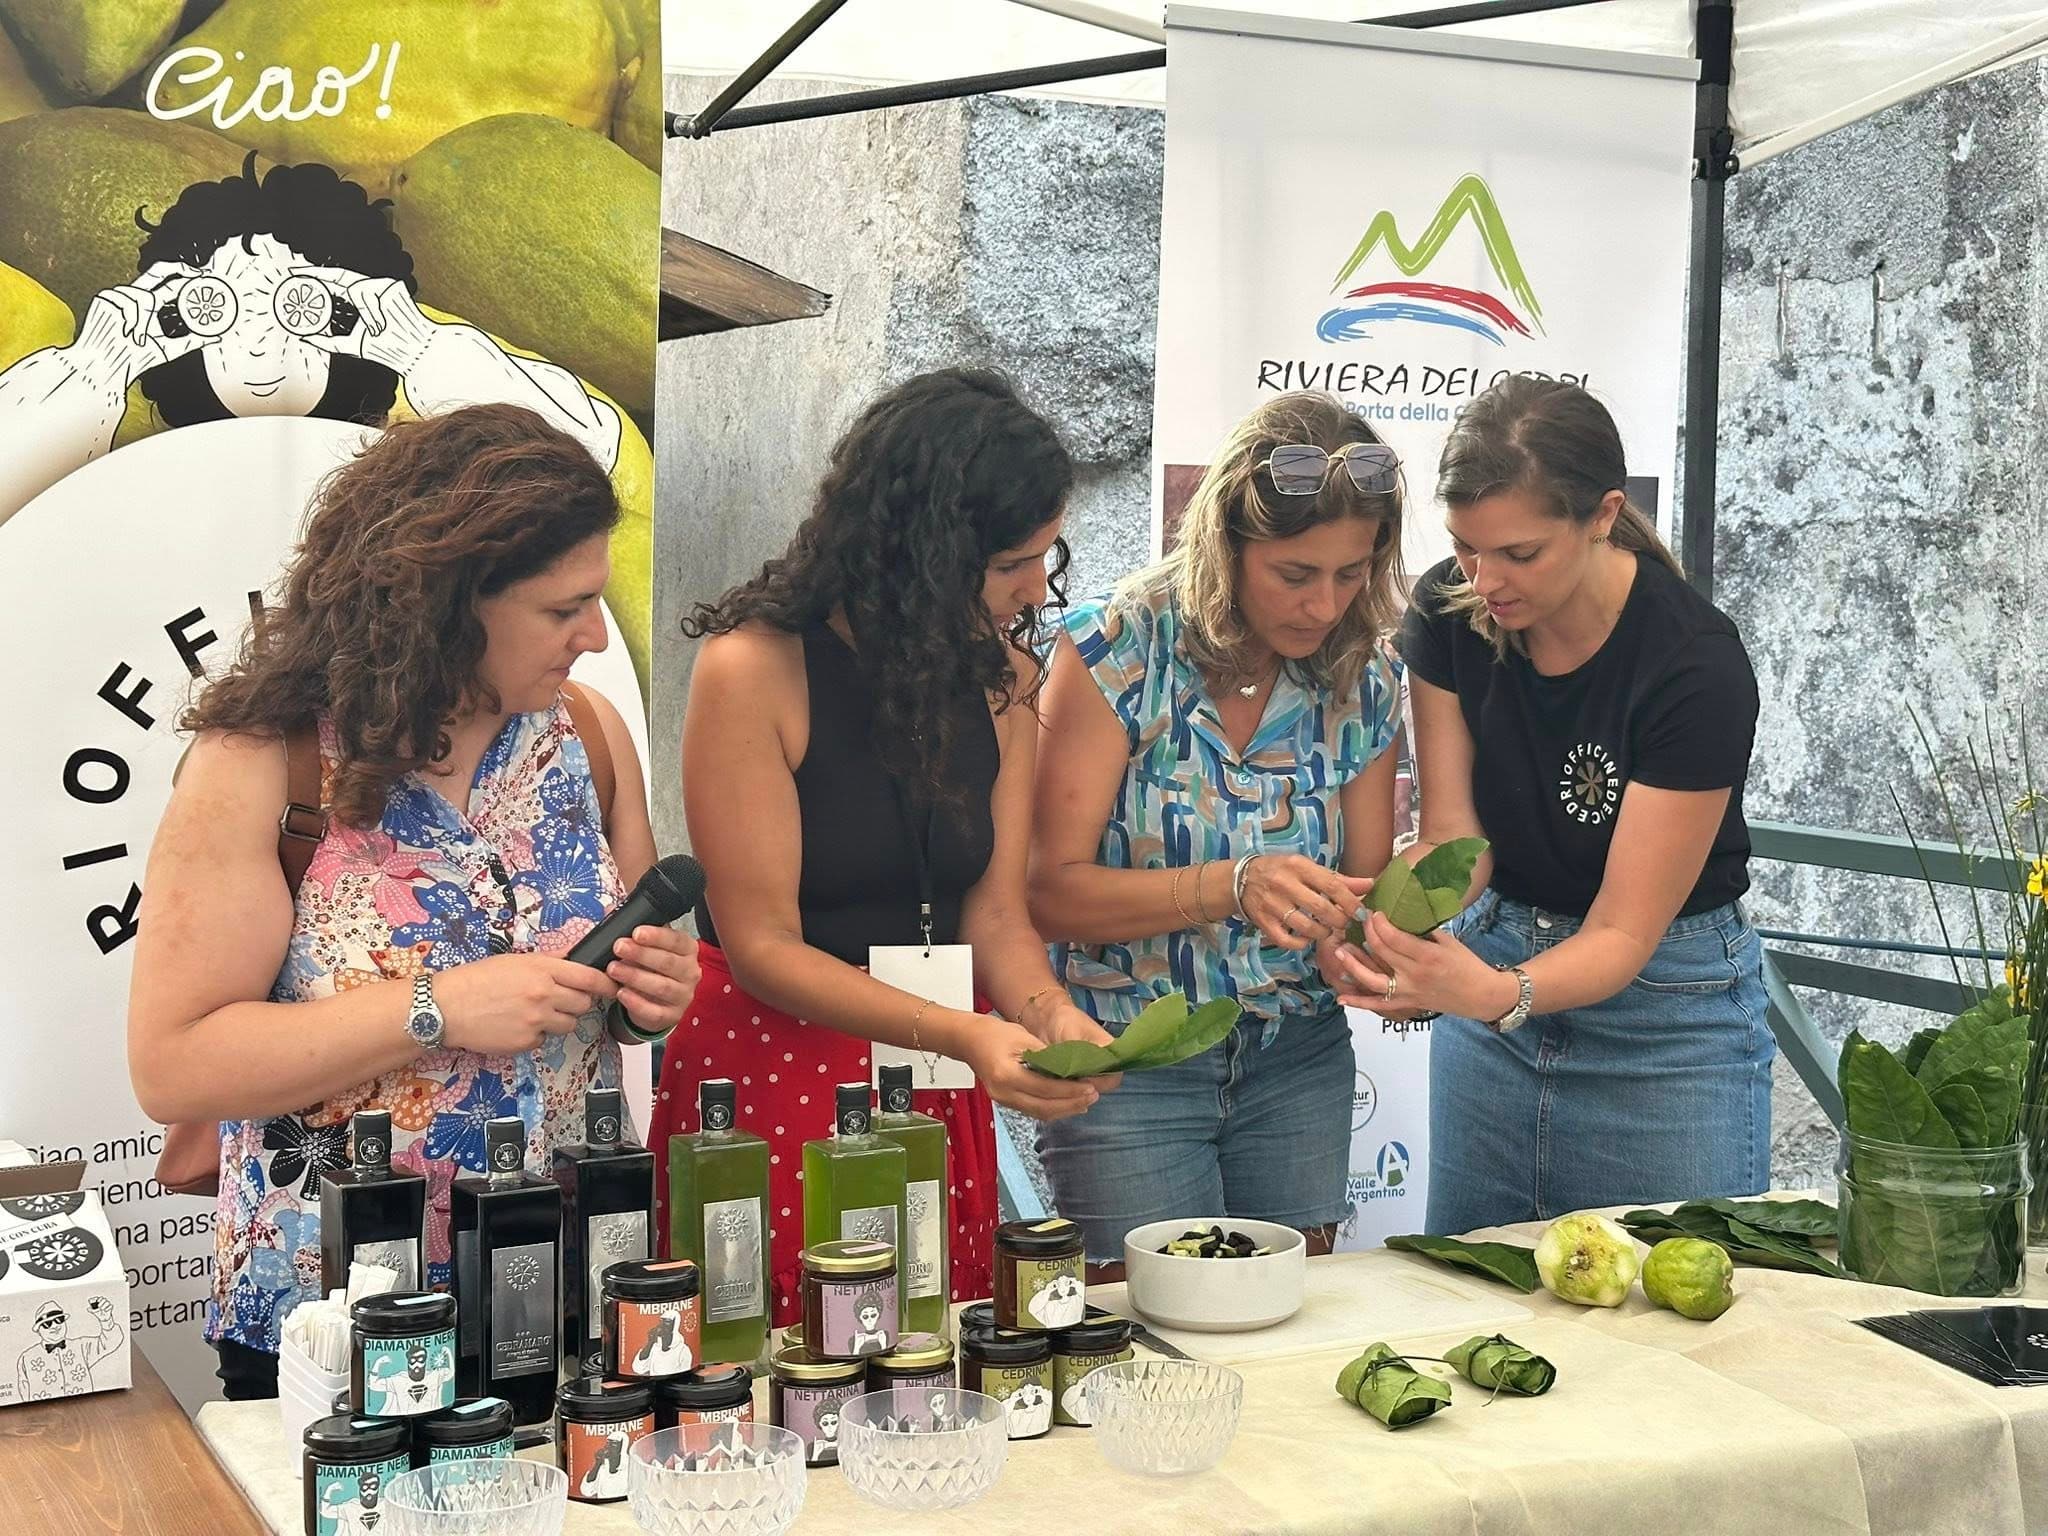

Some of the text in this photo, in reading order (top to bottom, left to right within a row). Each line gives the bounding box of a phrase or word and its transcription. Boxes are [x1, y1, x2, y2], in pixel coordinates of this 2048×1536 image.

[146, 41, 399, 130] Ciao!
[1257, 359, 1409, 396] RIVIERA
[1421, 365, 1479, 397] DEI
[1345, 401, 1394, 419] Porta
[1400, 402, 1449, 421] della
[93, 1127, 167, 1163] amic
[1346, 1177, 1376, 1189] Valle
[1346, 1187, 1405, 1203] Argentino
[907, 1261, 933, 1275] DRO
[1037, 1258, 1081, 1272] CEDRINA
[833, 1280, 895, 1296] NETTARINA
[364, 1336, 431, 1352] DIAMANTE
[1068, 1354, 1118, 1367] CEDRINA
[1001, 1364, 1047, 1380] CEDRINA
[794, 1383, 859, 1401] NETTARINA
[431, 1443, 496, 1460] DIAMANTE
[316, 1463, 384, 1479] DIAMANTE
